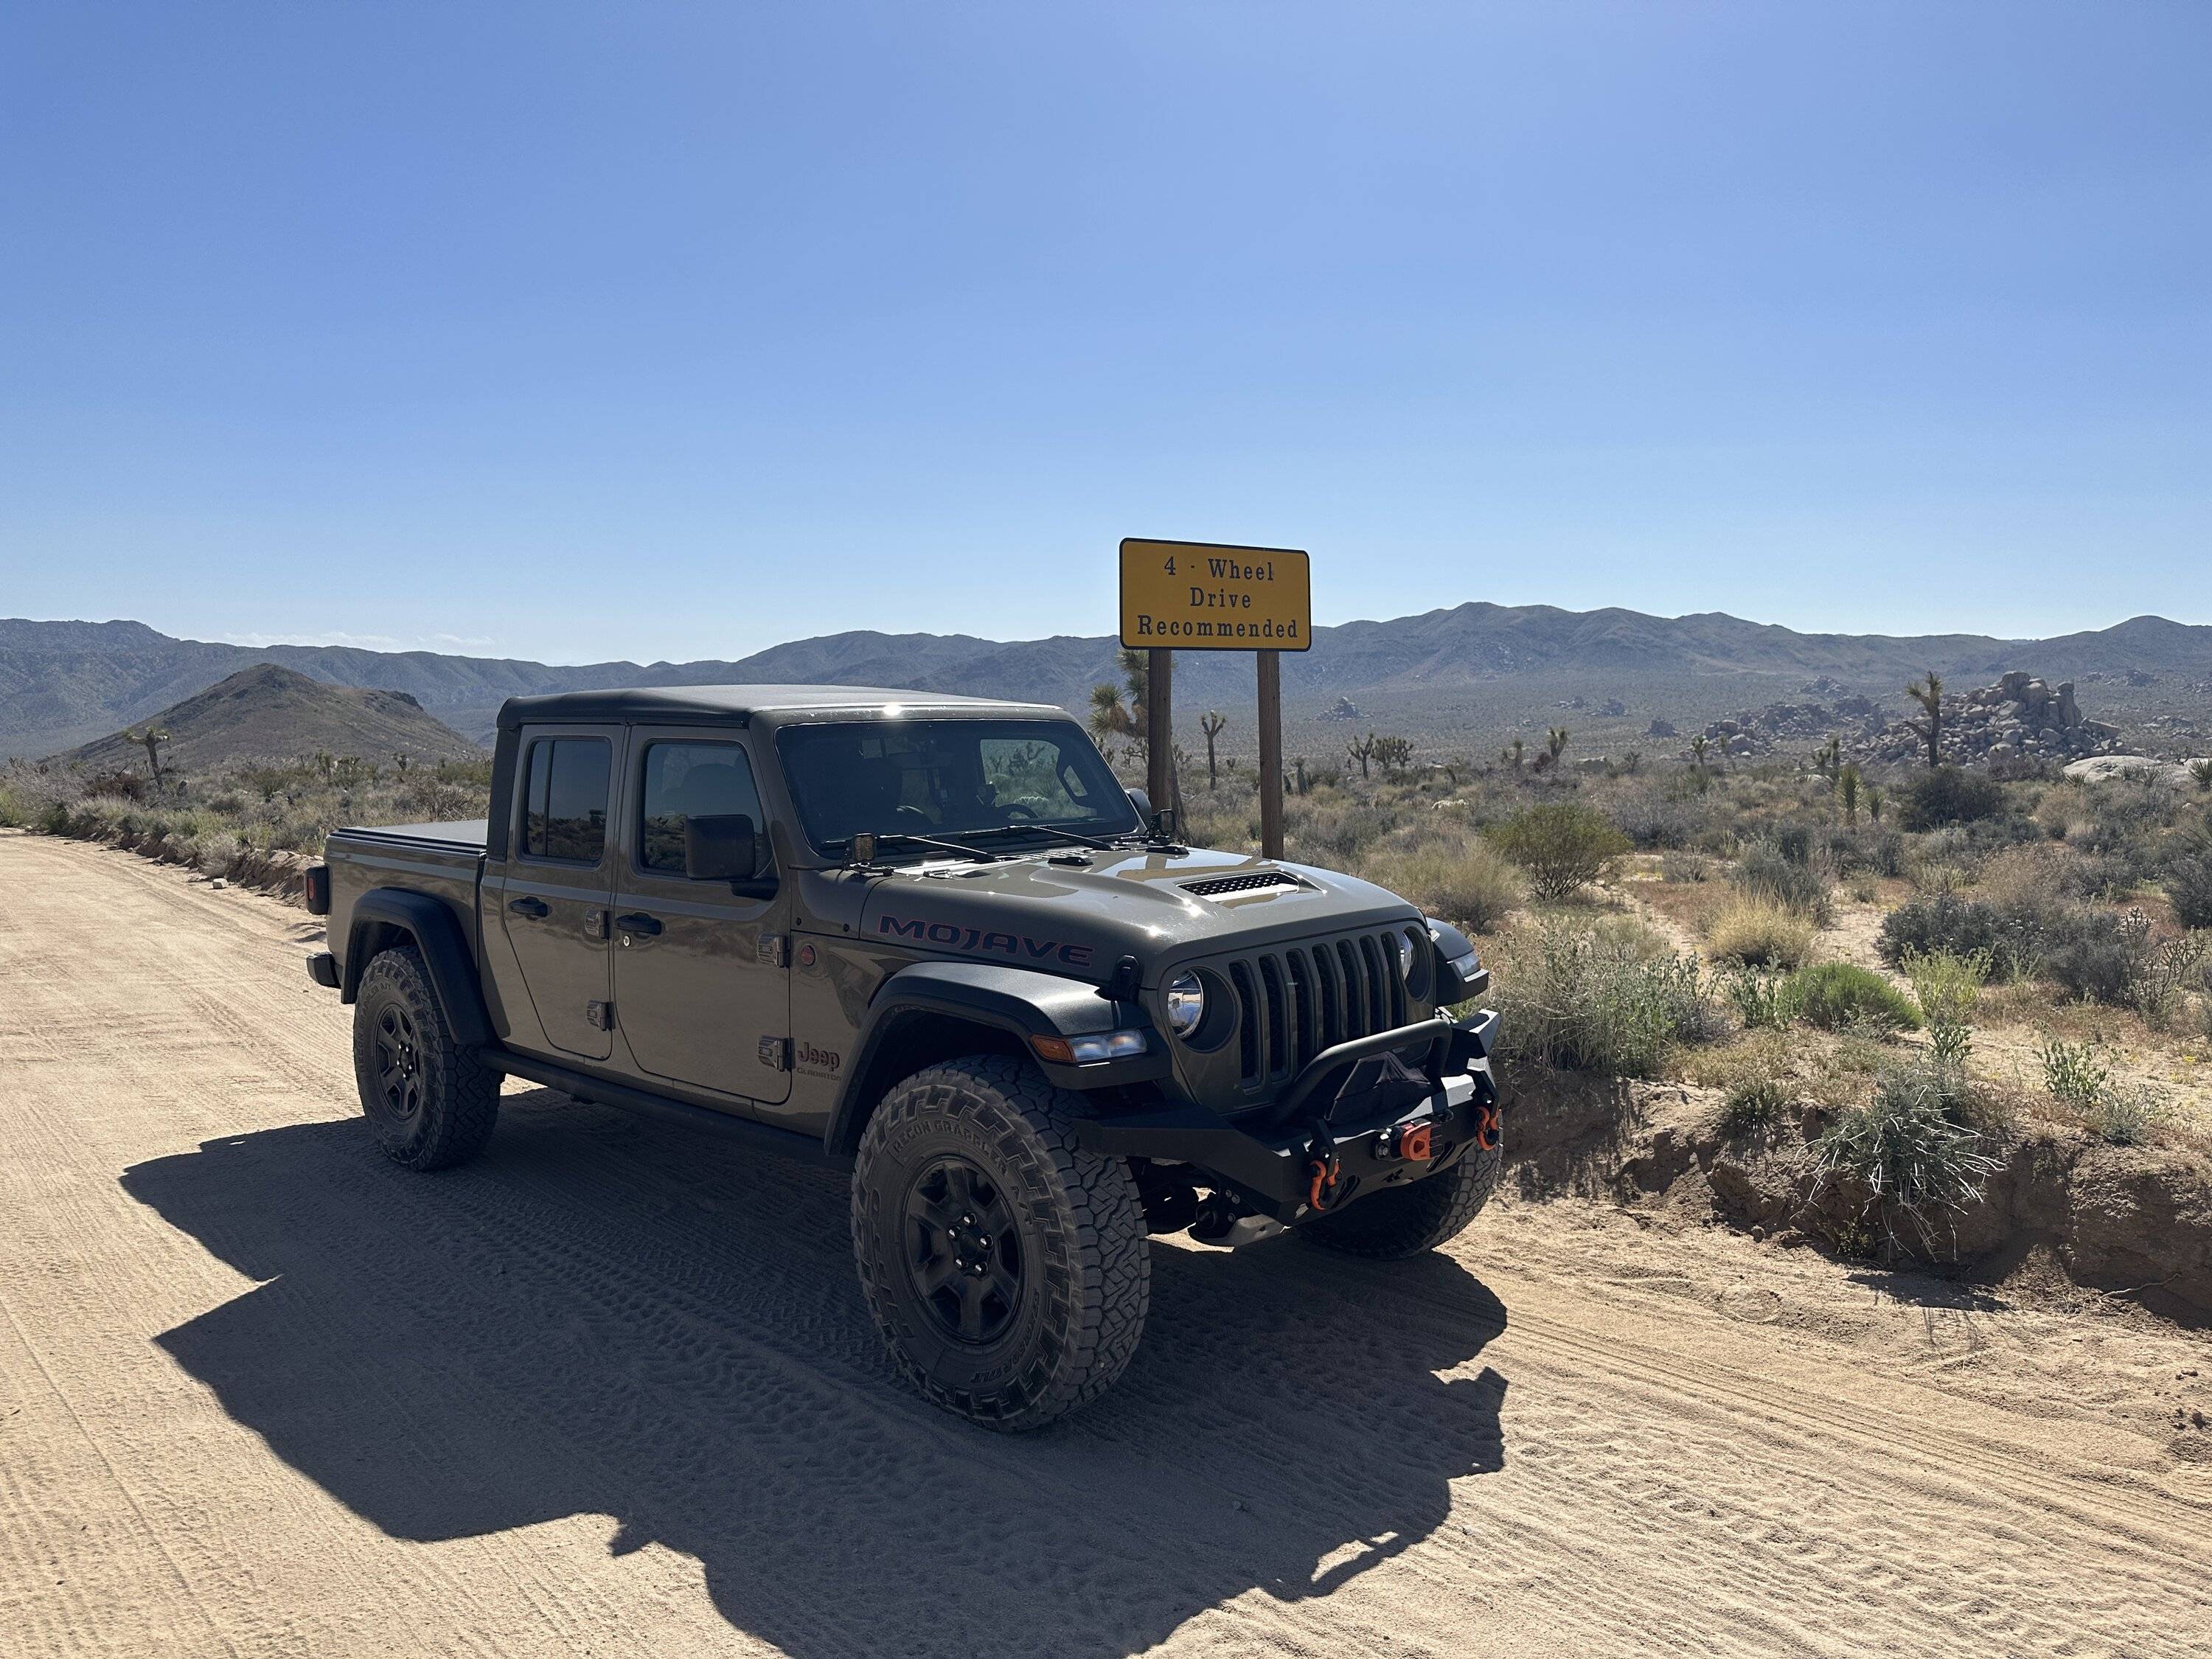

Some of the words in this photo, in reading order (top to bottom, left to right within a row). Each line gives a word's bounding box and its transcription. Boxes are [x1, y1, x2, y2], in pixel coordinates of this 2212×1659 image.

[1164, 556, 1175, 575] 4
[1208, 558, 1273, 580] Wheel
[1189, 587, 1251, 608] Drive
[1137, 615, 1298, 638] Recommended
[879, 914, 1094, 967] MOJAVE
[797, 1041, 841, 1071] Jeep
[893, 1119, 933, 1153] RECON
